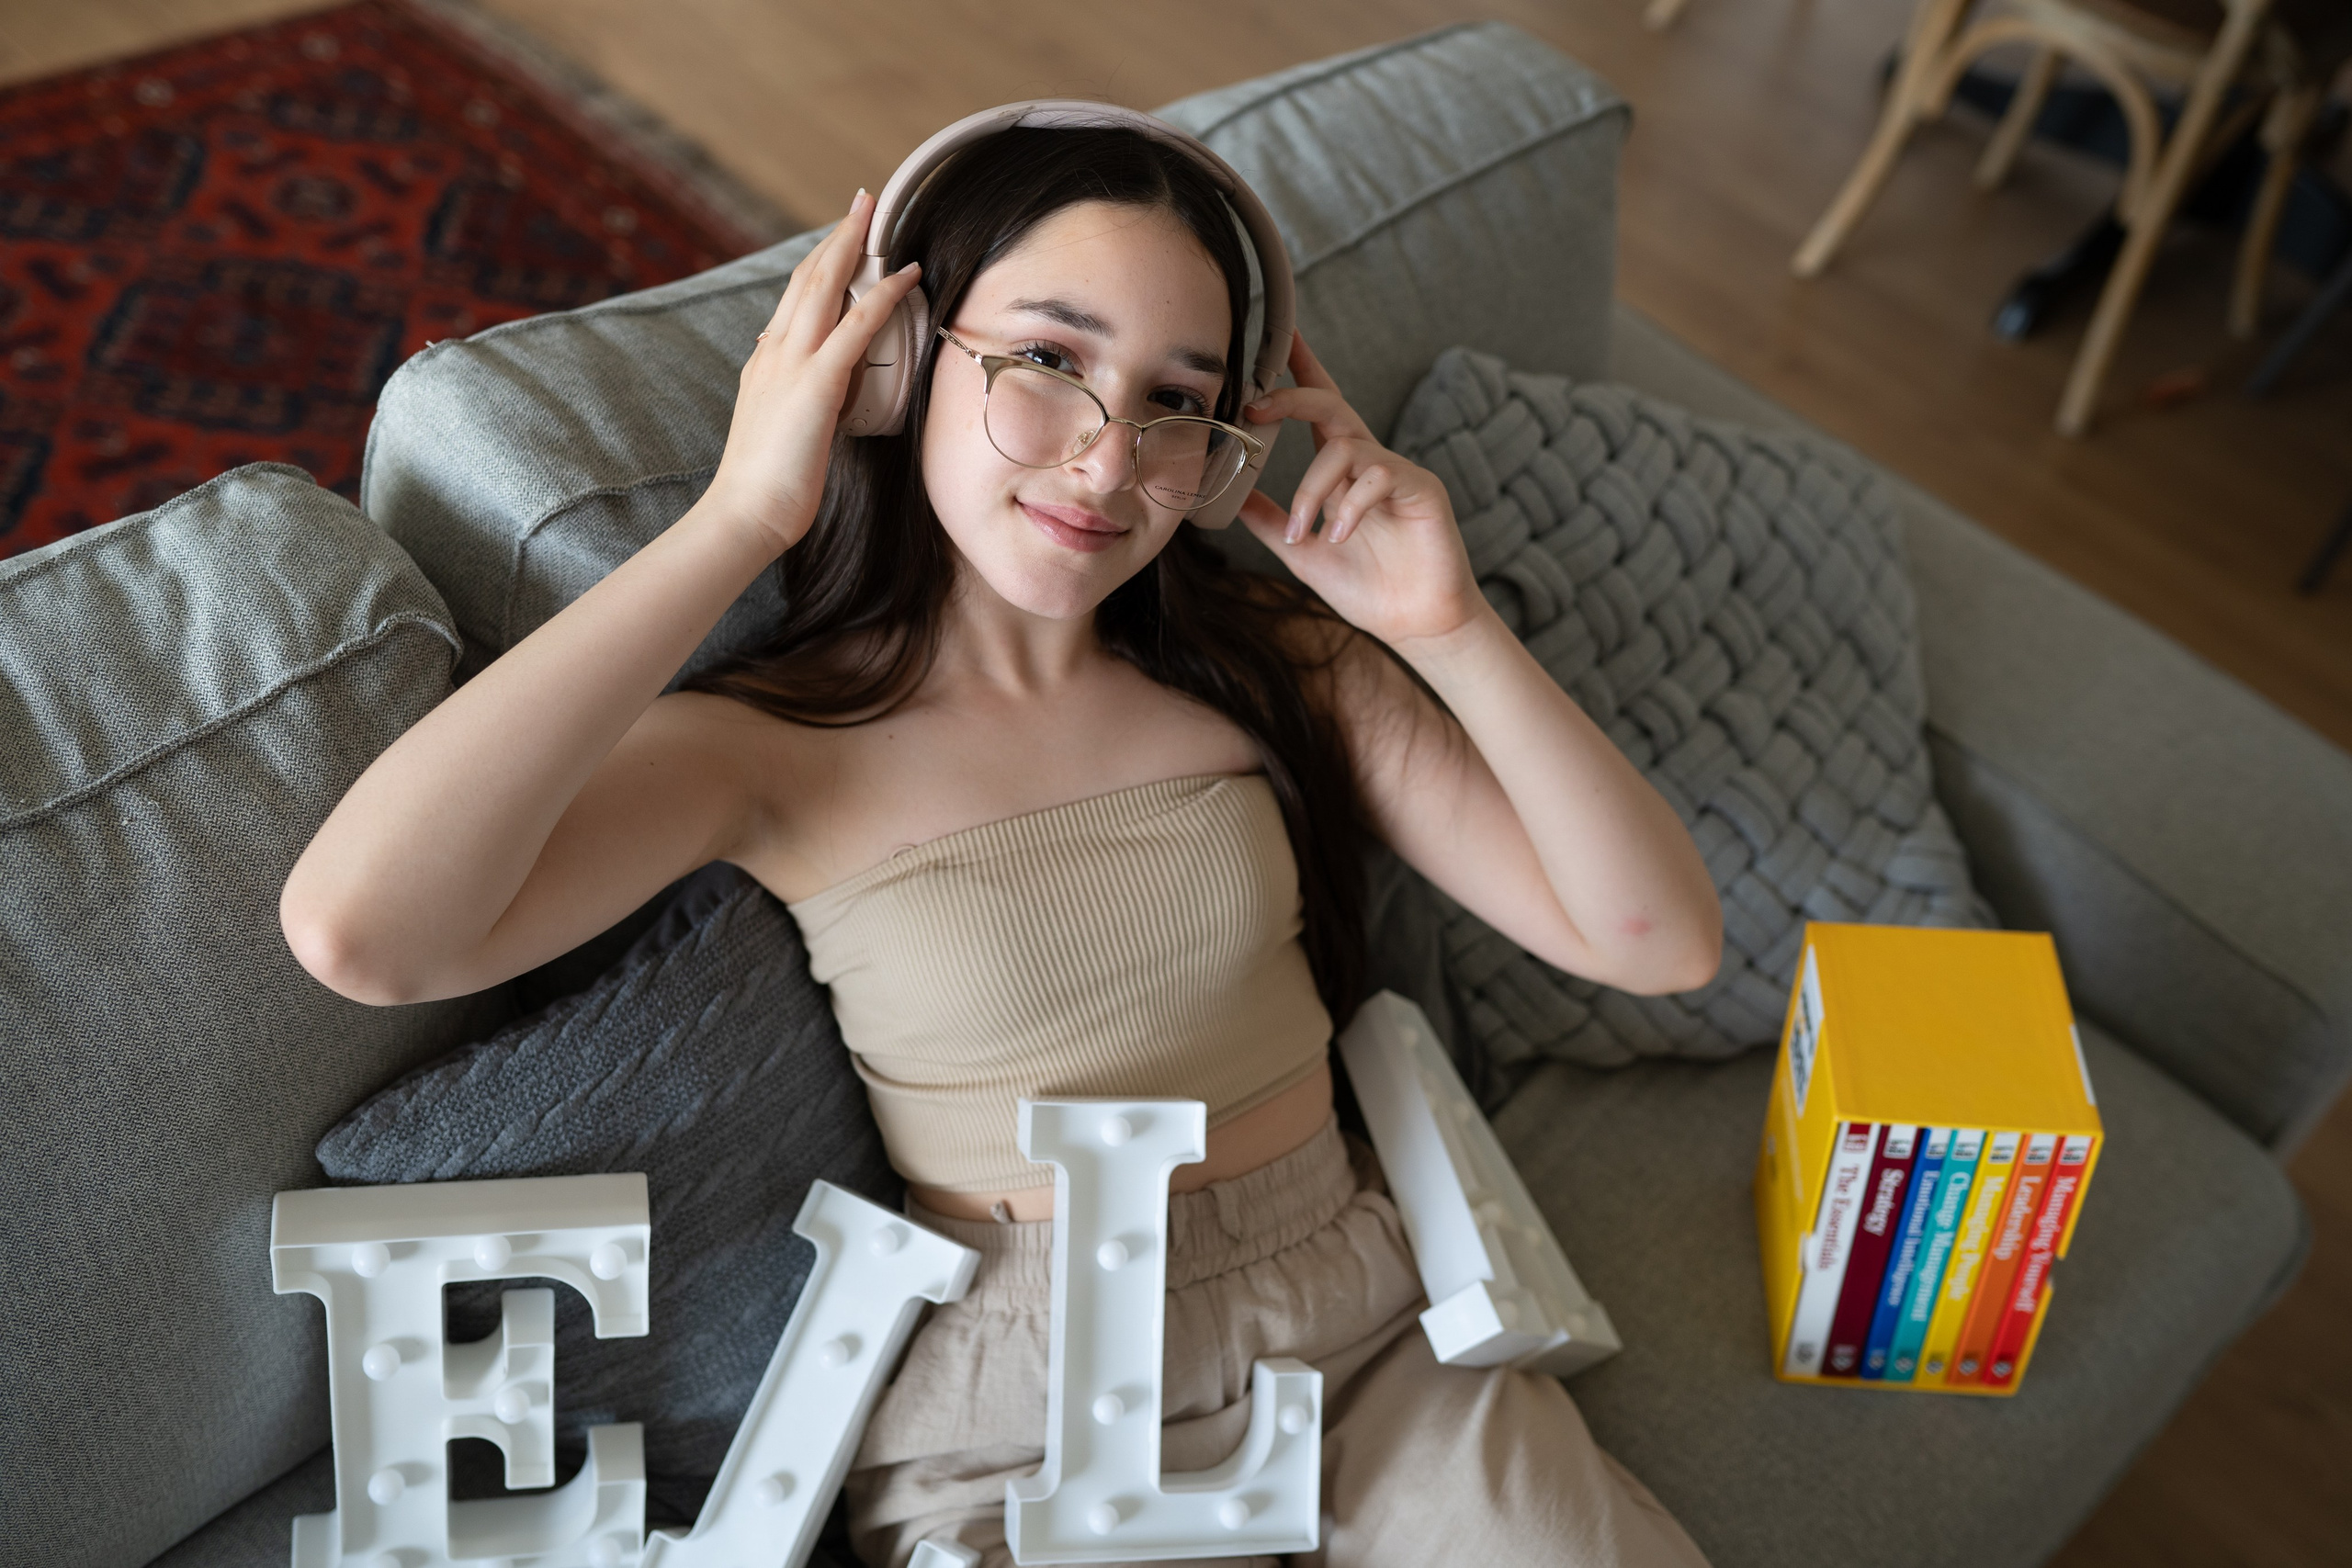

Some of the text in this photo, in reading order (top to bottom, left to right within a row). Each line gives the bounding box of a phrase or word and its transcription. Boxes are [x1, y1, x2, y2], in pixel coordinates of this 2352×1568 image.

[1155, 485, 1185, 495] CAROLINA
[1835, 1163, 1860, 1195] The
[1863, 1168, 1905, 1237] Strategy
[1935, 1171, 1972, 1230] Change
[1960, 1175, 2006, 1251] Managing
[2030, 1176, 2077, 1250] Managing
[1817, 1198, 1852, 1271] Essentials
[1993, 1175, 2042, 1260] Leadership
[1911, 1231, 1954, 1322] Management
[1948, 1252, 1981, 1301] People
[2014, 1250, 2053, 1313] Yourself
[1004, 1097, 1323, 1565] L
[270, 1172, 650, 1568] E
